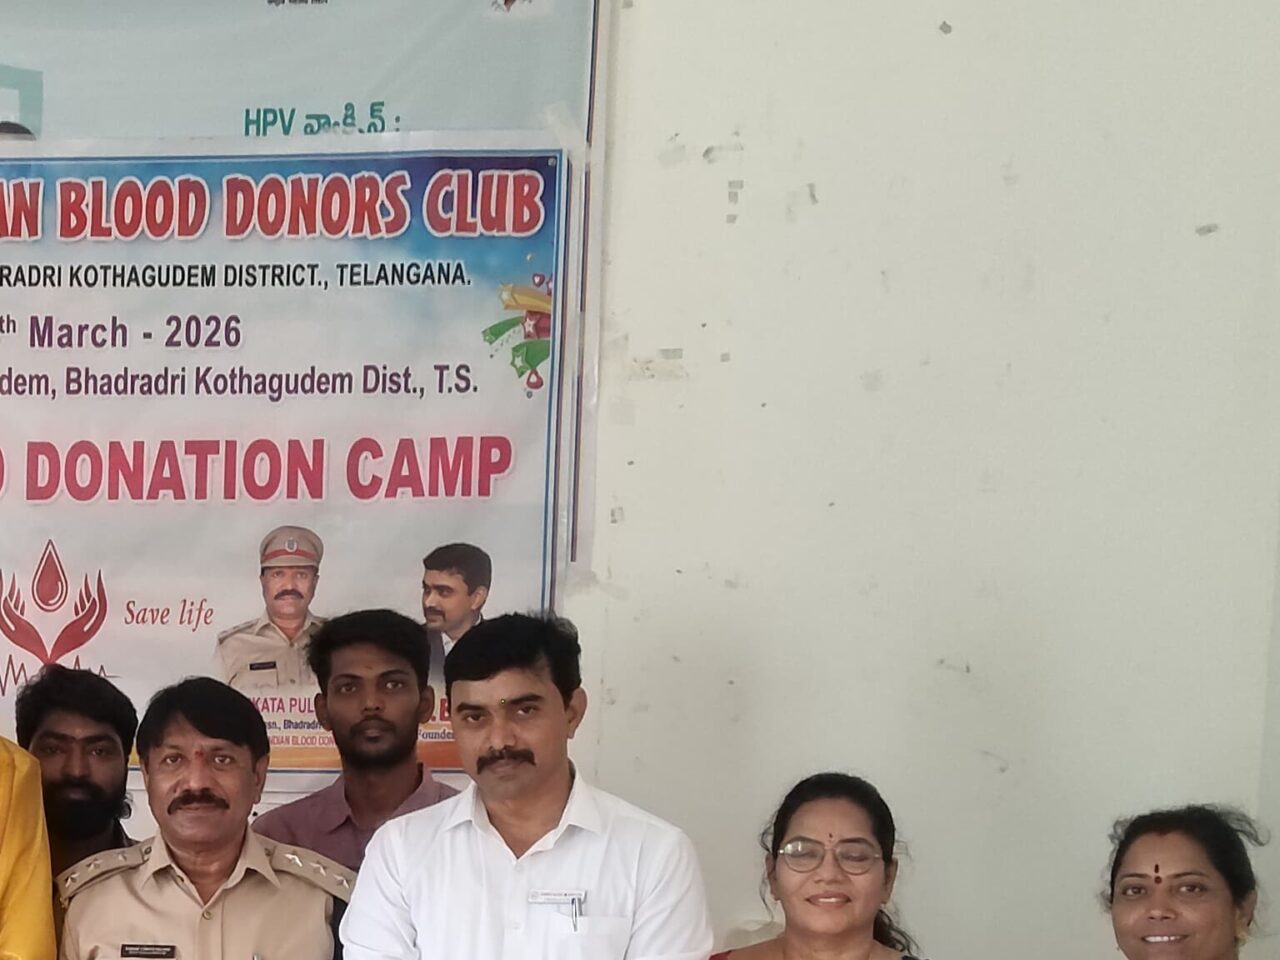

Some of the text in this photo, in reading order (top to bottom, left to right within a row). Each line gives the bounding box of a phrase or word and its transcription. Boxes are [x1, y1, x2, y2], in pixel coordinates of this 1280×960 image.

[245, 108, 295, 136] HPV
[58, 177, 208, 240] BLOOD
[224, 173, 410, 239] DONORS
[424, 170, 543, 236] CLUB
[69, 264, 216, 288] KOTHAGUDEM
[224, 263, 328, 290] DISTRICT.,
[336, 262, 471, 287] TELANGANA.
[29, 315, 128, 348] March
[165, 315, 241, 348] 2026
[65, 366, 186, 396] Bhadradri
[195, 366, 353, 402] Kothagudem
[362, 364, 425, 399] Dist.,
[434, 364, 478, 394] T.S.
[26, 438, 325, 501] DONATION
[346, 435, 513, 499] CAMP
[124, 598, 214, 632] Save life
[252, 697, 314, 713] KATA PUL
